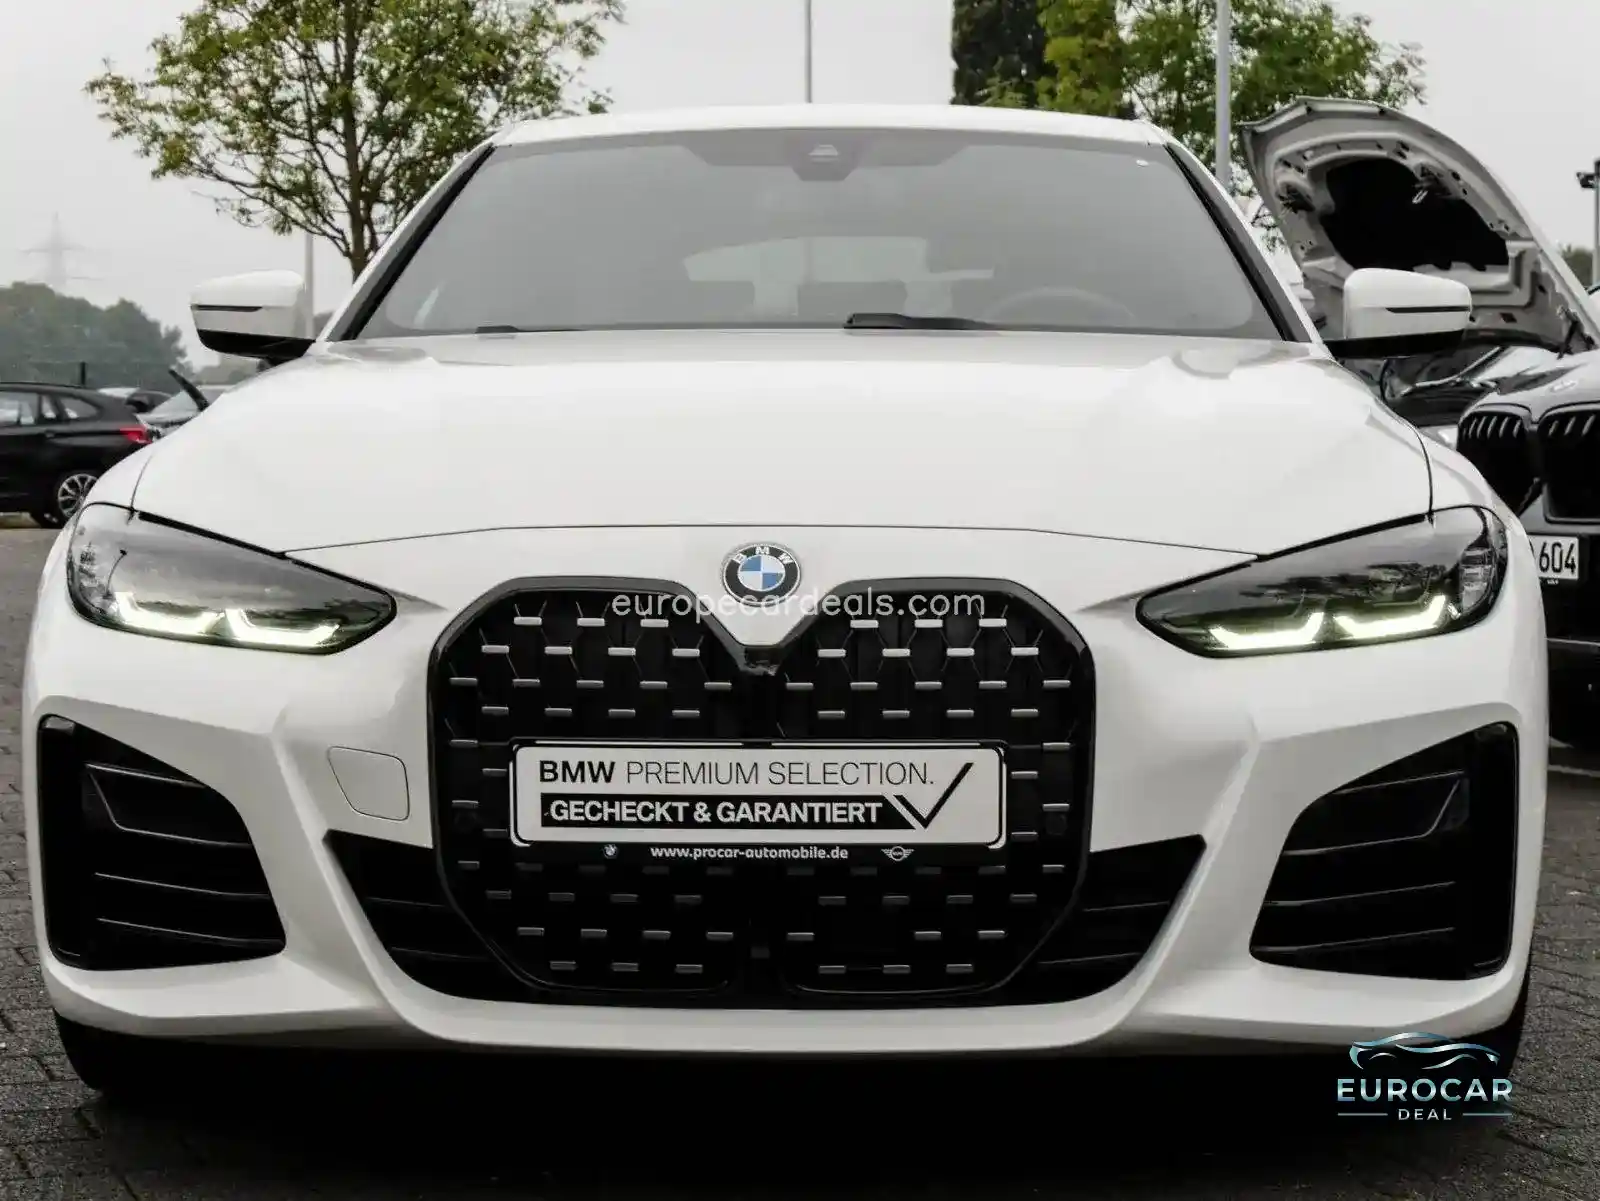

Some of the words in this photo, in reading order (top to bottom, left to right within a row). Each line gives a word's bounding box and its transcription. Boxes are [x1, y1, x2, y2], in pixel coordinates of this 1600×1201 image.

[539, 760, 616, 783] BMW
[626, 761, 759, 785] PREMIUM
[767, 762, 935, 786] SELECTION.
[549, 799, 689, 823] GECHECKT
[693, 801, 711, 823] &
[716, 801, 882, 824] GARANTIERT
[650, 845, 849, 861] www.procar-automobile.de
